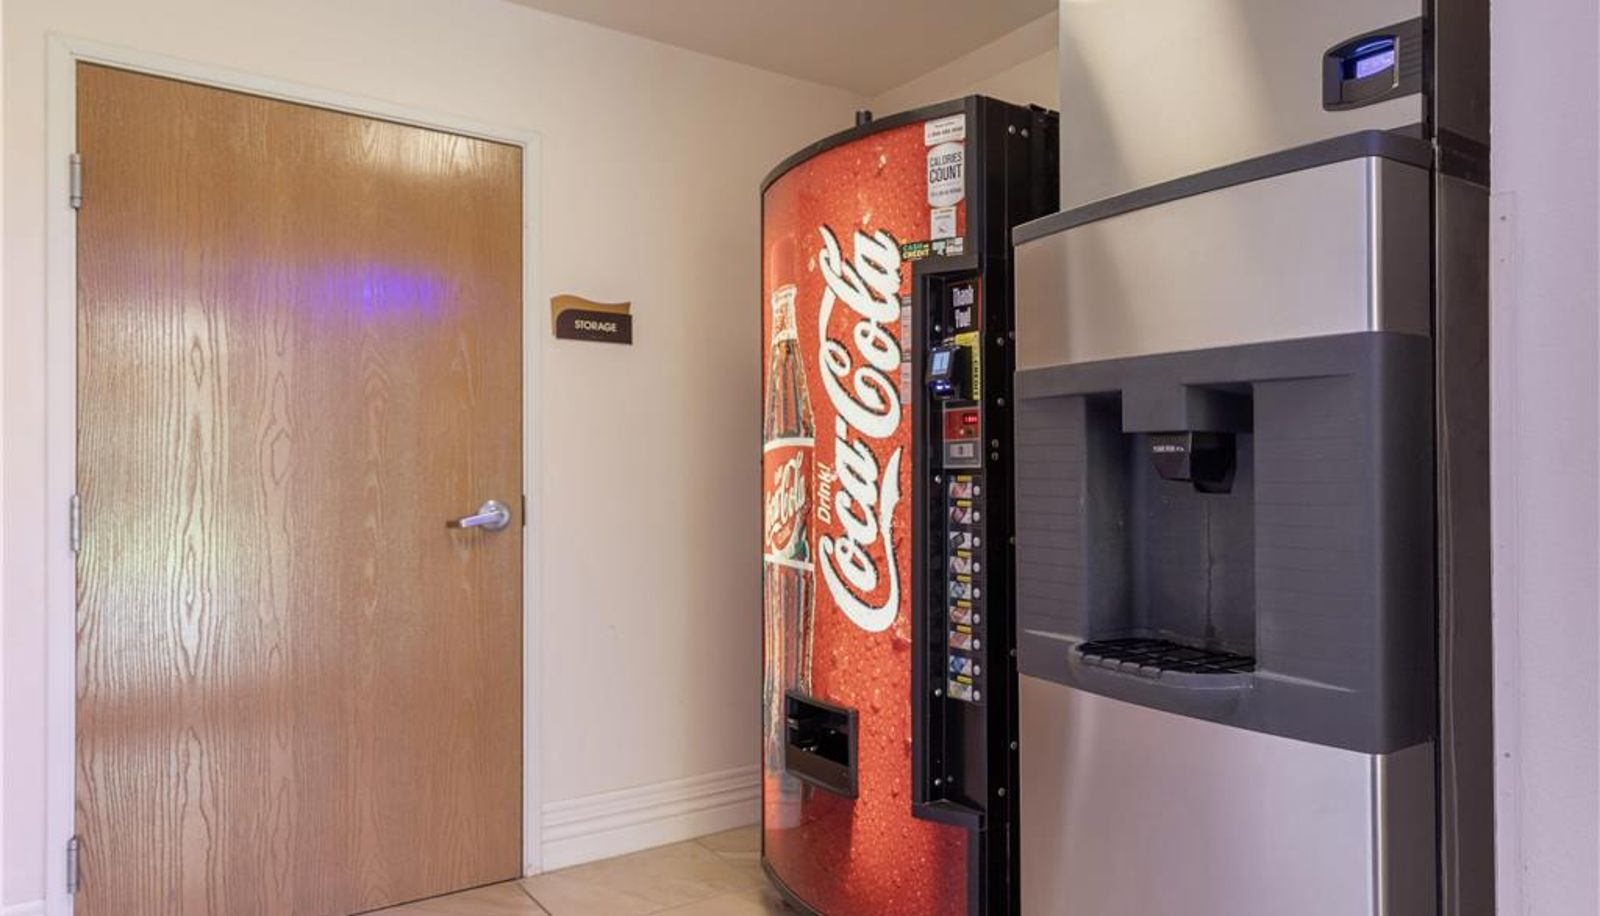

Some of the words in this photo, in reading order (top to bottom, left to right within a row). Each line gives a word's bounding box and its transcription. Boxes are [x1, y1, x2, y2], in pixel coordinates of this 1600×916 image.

[929, 152, 963, 168] CALORIES
[929, 164, 962, 183] COUNT
[903, 249, 929, 259] CREDIT
[952, 284, 974, 308] Thank
[574, 319, 617, 332] STORAGE
[955, 306, 971, 328] You!
[818, 224, 903, 632] Coca-Cola
[817, 461, 834, 525] Drink!
